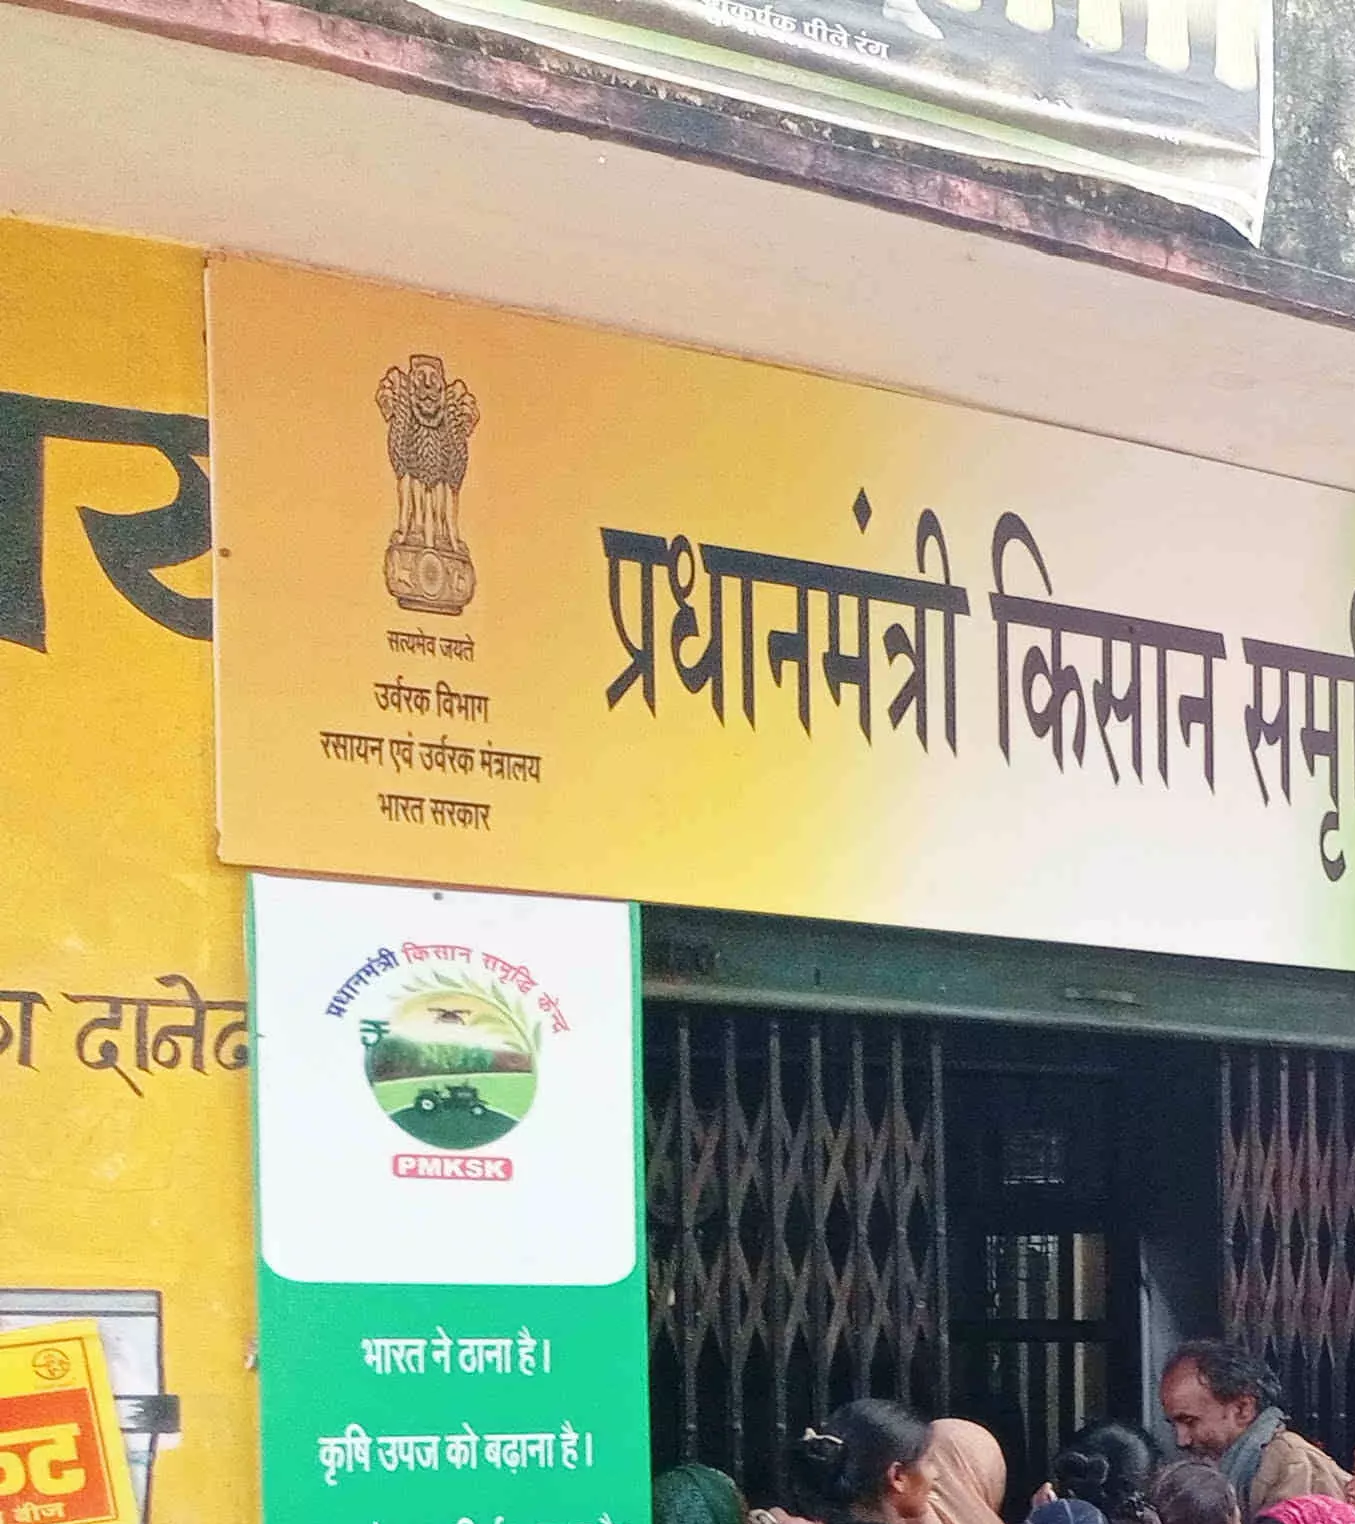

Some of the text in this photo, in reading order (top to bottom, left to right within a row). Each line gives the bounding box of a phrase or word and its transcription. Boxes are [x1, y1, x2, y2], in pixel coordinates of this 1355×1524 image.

[801, 18, 850, 48] पीले
[854, 30, 890, 60] रंग
[387, 627, 475, 662] सत्यमेव जयते
[600, 486, 971, 759] प्रधानमंत्री
[988, 511, 1227, 794] किसान
[374, 675, 489, 723] उर्वरक विभाग
[319, 731, 541, 783] रसायन एवं उर्वरक मंत्रालय
[377, 792, 490, 831] भारत सरकार
[325, 946, 400, 1018] प्रधानमंत्री
[401, 942, 473, 964] किसान
[397, 1156, 506, 1178] PMKSK
[361, 1326, 551, 1376] भारत ने ठाना है।
[317, 1420, 594, 1485] कृषि उपज को बढ़ाना है।
